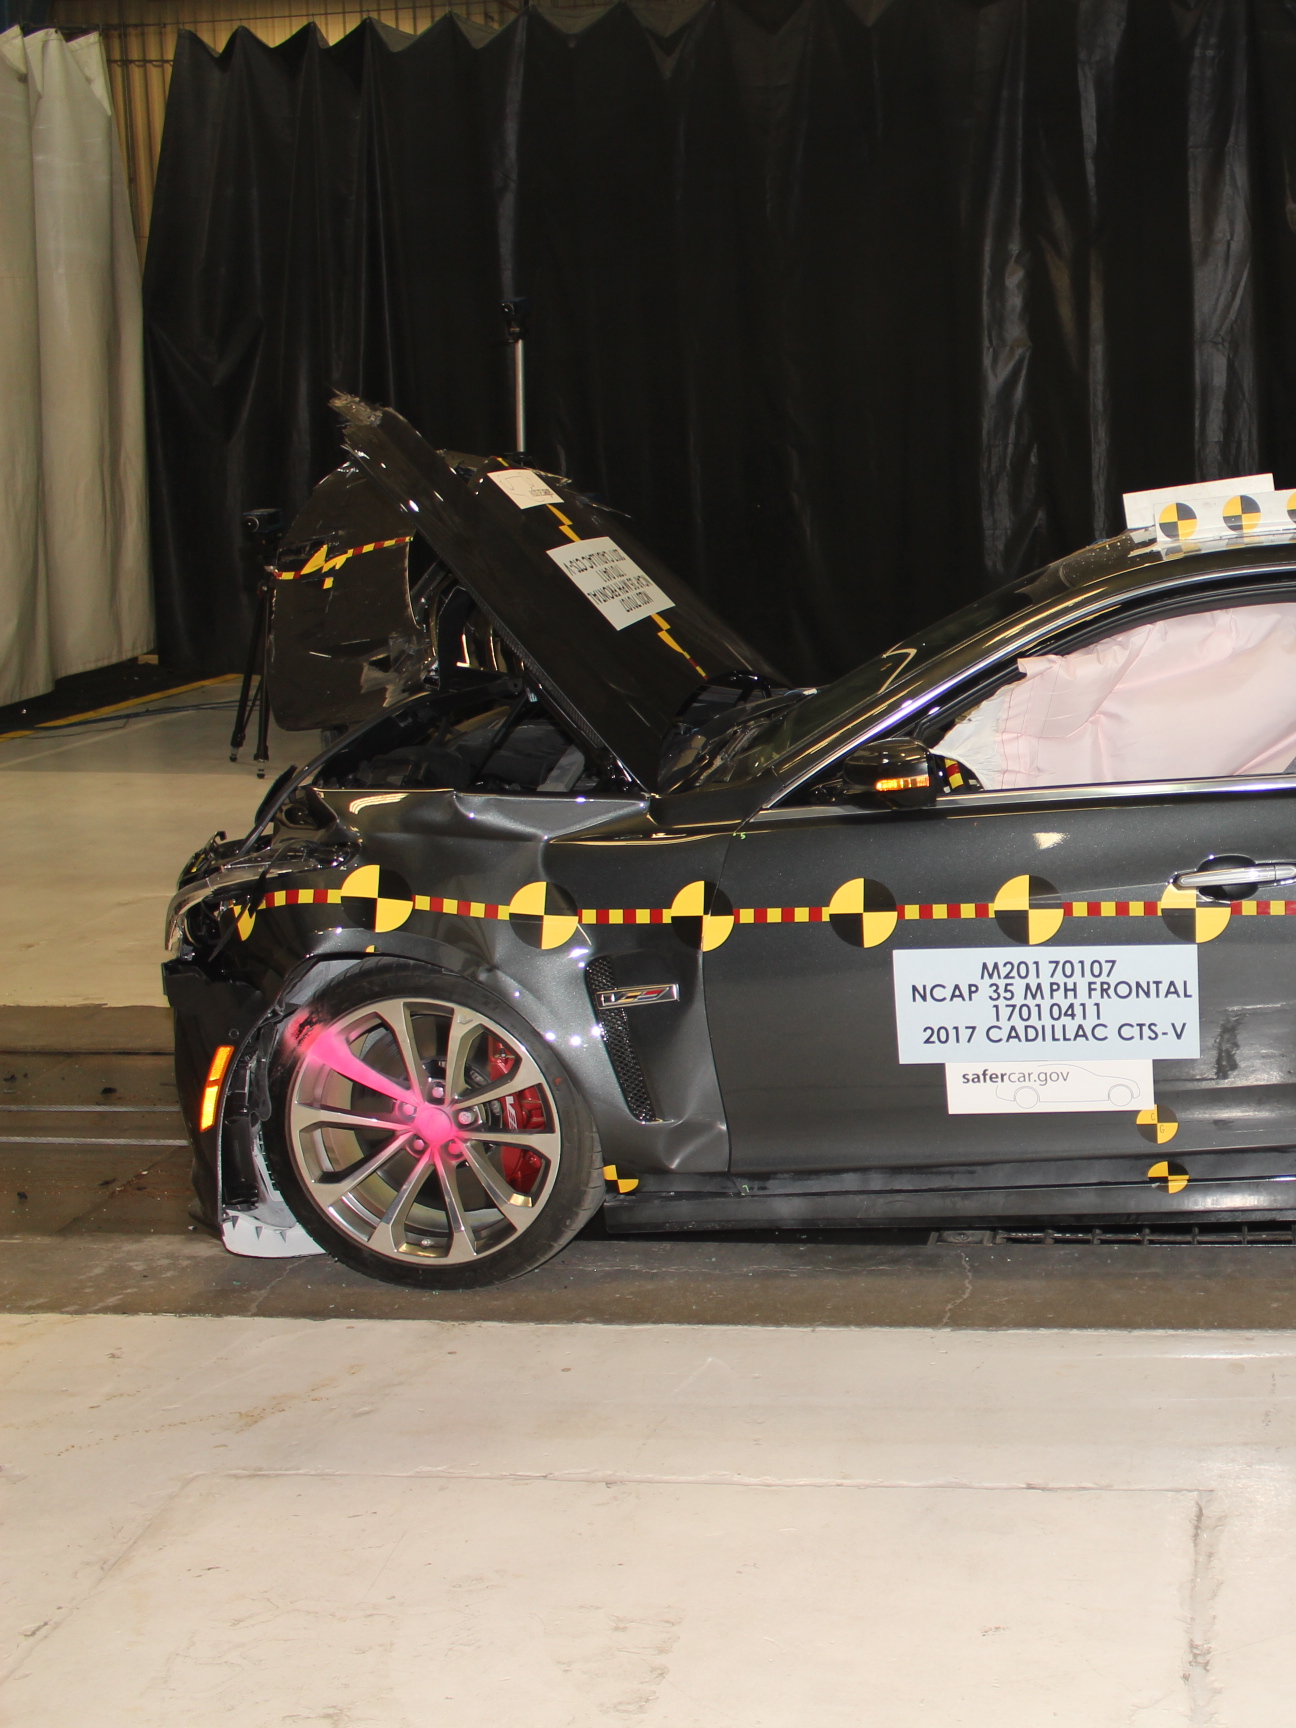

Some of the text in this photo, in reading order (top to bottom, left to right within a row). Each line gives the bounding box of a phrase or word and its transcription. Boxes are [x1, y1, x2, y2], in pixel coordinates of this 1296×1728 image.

[587, 584, 621, 605] FRONTAL
[981, 960, 1117, 980] M20170107
[911, 980, 1193, 1003] NCAP 35 MPH FRONTAL
[992, 1003, 1102, 1023] 17010411
[922, 1022, 1187, 1045] 2017 CADILLAC CTS-V
[962, 1069, 1070, 1086] safercar.gov
[1151, 1112, 1156, 1121] C
[1160, 1124, 1165, 1134] G
